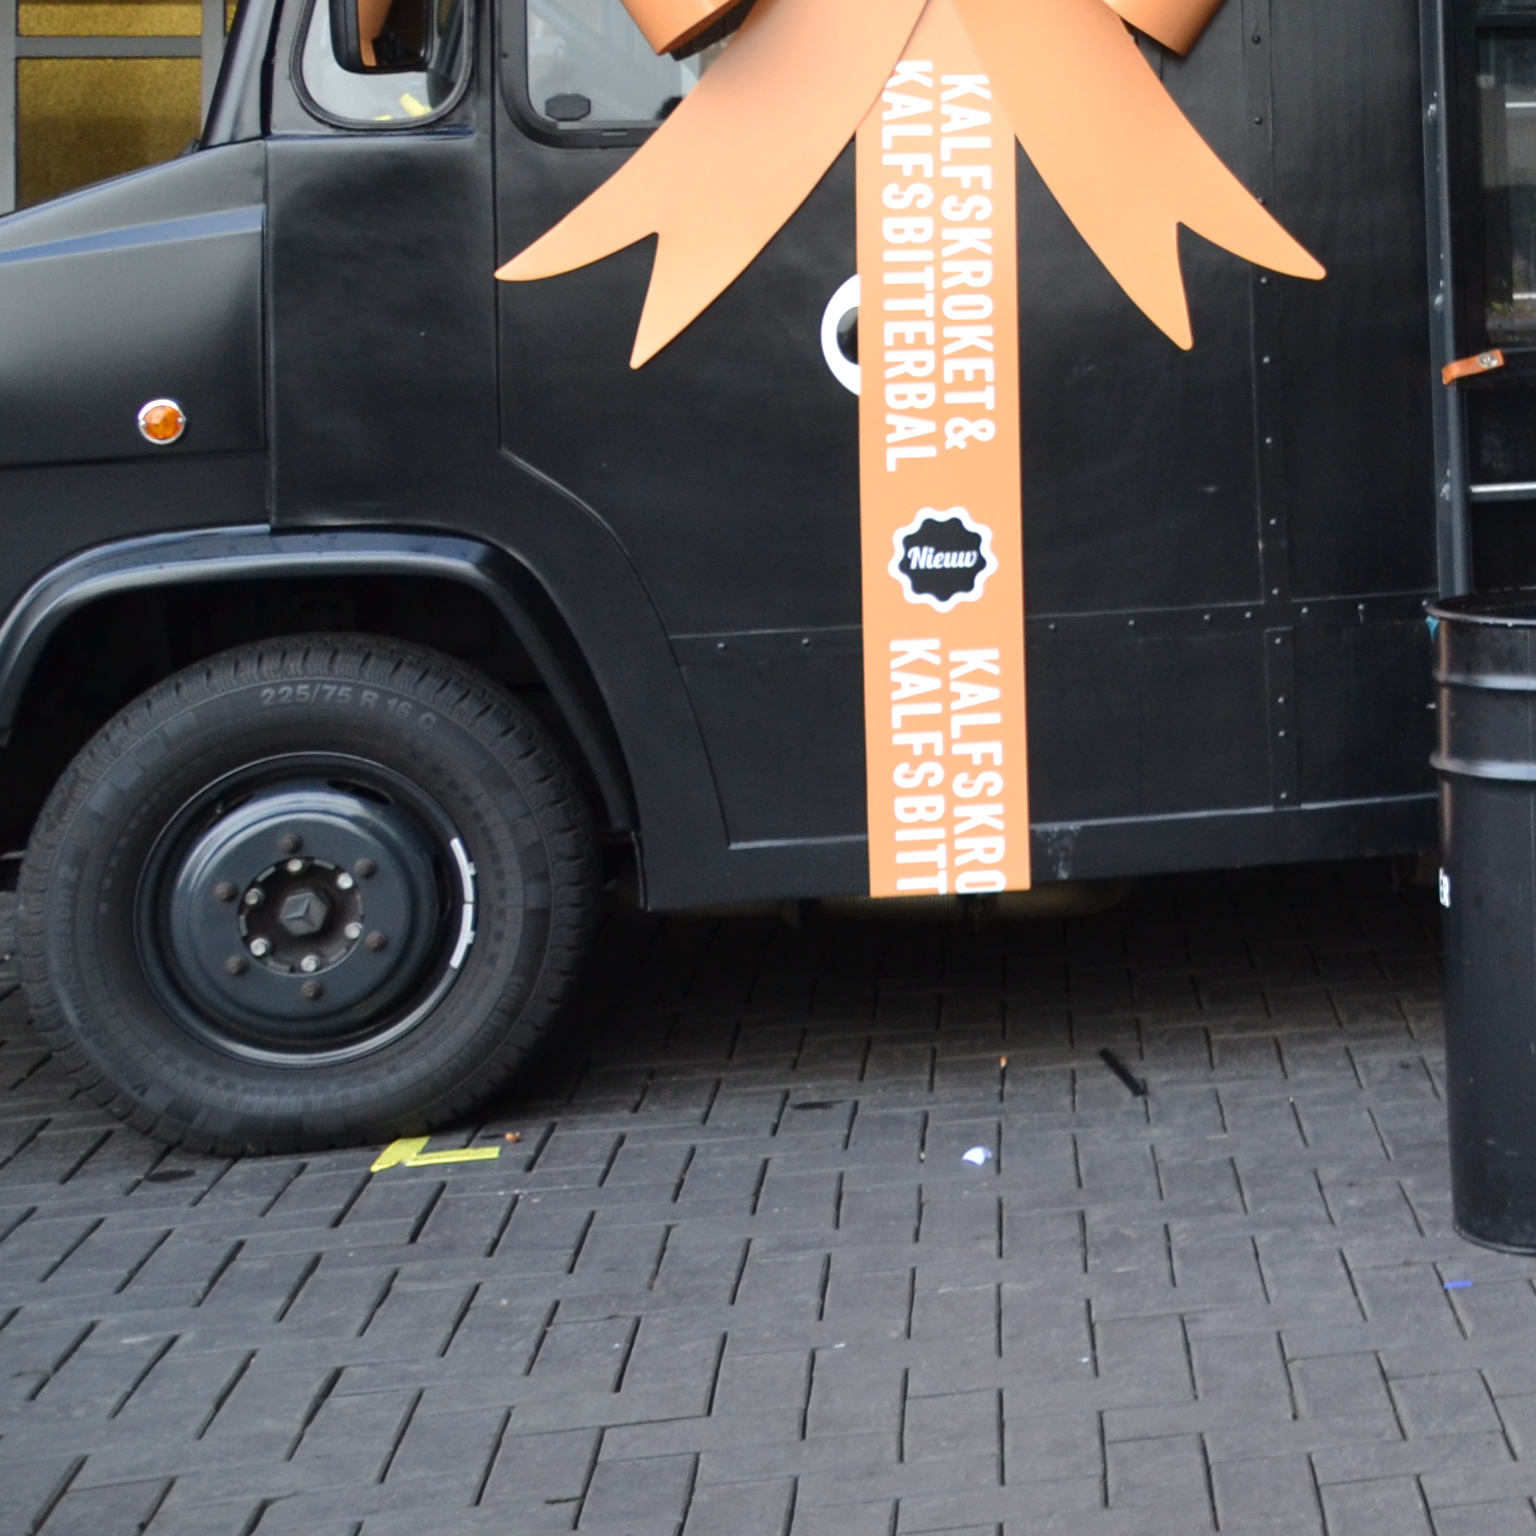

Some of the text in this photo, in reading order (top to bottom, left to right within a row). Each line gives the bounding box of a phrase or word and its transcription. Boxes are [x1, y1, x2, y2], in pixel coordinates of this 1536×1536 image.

[881, 59, 937, 473] KALFSBITTERBAL
[940, 74, 996, 451] KALFSKROKET &
[907, 545, 979, 571] Nieuw
[260, 683, 353, 707] 225/75
[360, 690, 379, 709] R
[387, 697, 413, 719] 16
[889, 638, 948, 895] KALFSBITT
[948, 648, 1006, 894] KALFSKRO
